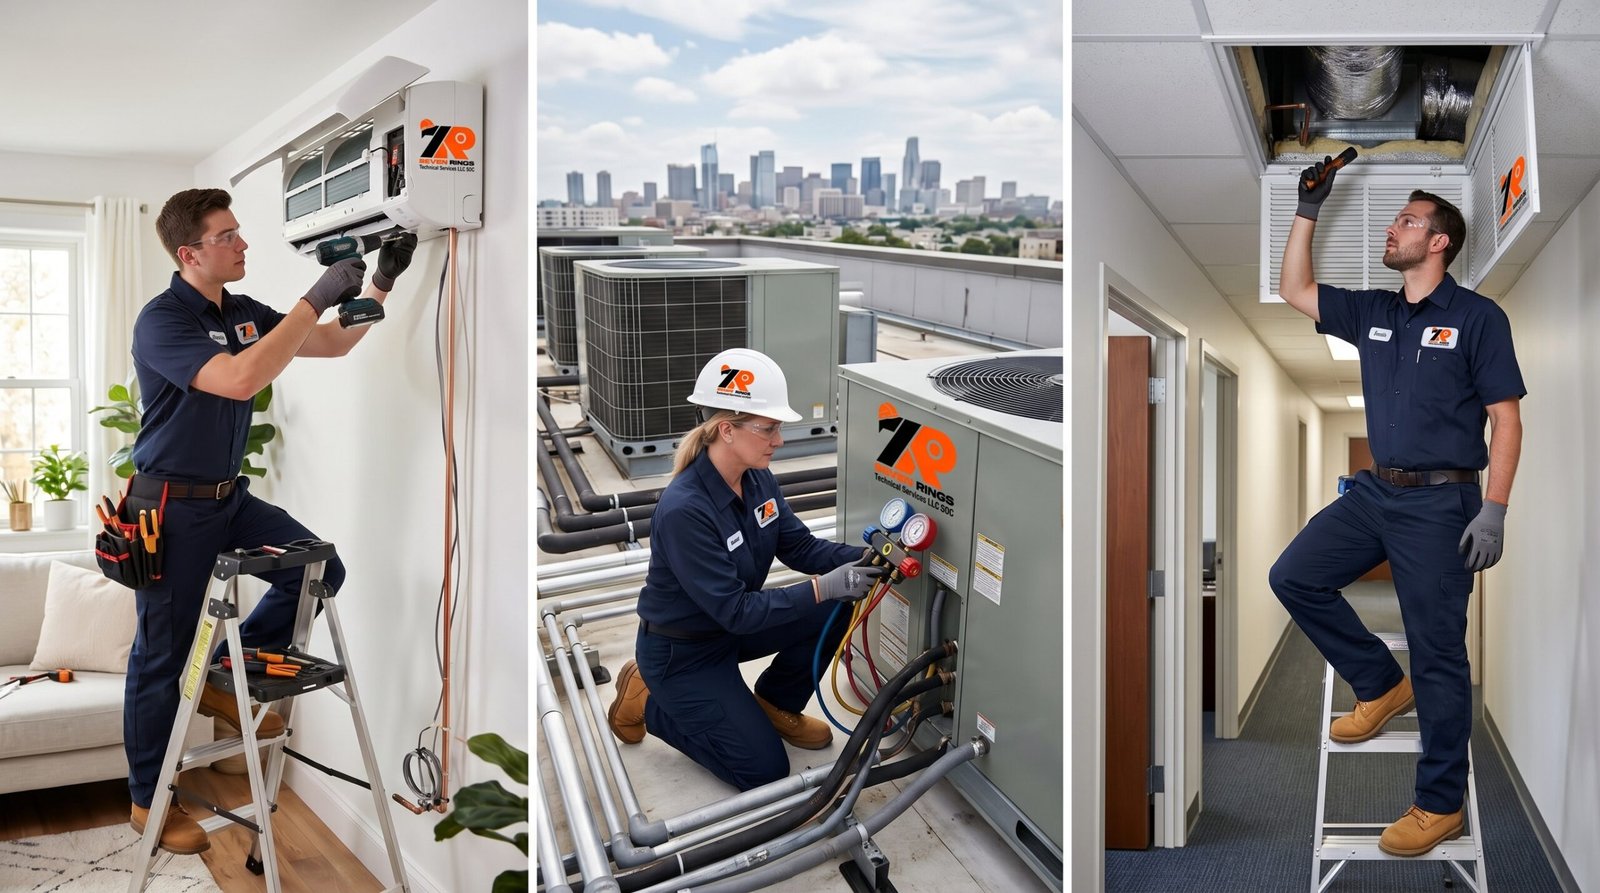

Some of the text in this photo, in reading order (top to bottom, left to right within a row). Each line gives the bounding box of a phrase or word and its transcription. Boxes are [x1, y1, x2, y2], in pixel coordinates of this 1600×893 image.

[874, 472, 955, 517] Technical Services LLC SOC
[916, 481, 955, 506] RINGS
